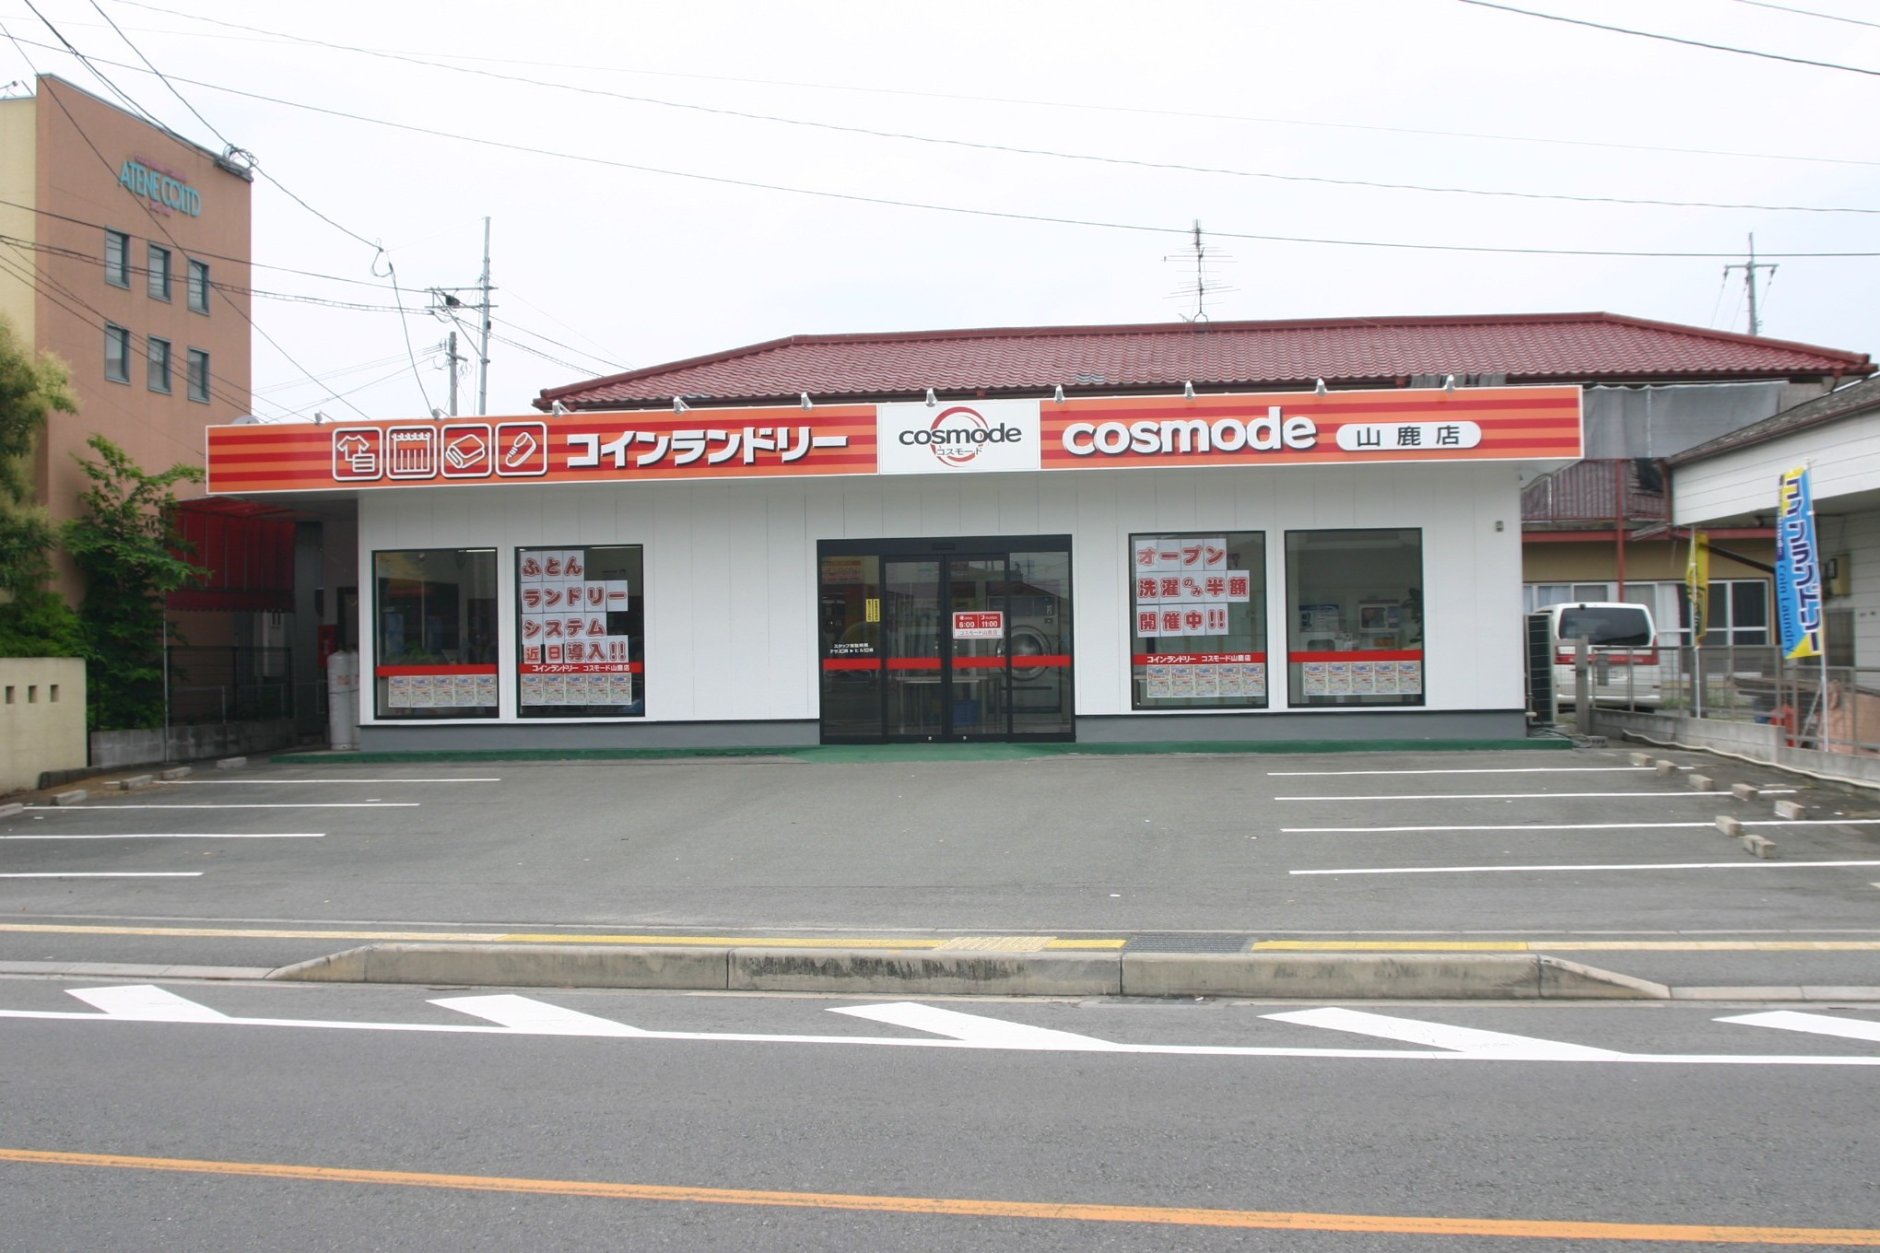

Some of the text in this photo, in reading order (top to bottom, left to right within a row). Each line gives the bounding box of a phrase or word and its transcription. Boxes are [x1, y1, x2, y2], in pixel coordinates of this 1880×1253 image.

[120, 160, 161, 202] ATENE
[898, 422, 1022, 445] cosmode
[1062, 406, 1317, 455] cosmode
[1356, 425, 1461, 447] 山鹿店
[566, 427, 848, 468] コインランドリー
[936, 446, 983, 456] コスモード
[521, 556, 583, 577] ふとん
[1137, 545, 1225, 567] オープン
[1137, 576, 1249, 598] 洗濯のみ半額
[1778, 564, 1788, 594] Coin
[523, 586, 626, 606] ランドリー
[523, 618, 608, 639] システム
[1781, 597, 1796, 653] Laundry
[1147, 655, 1197, 663] コインランドリー
